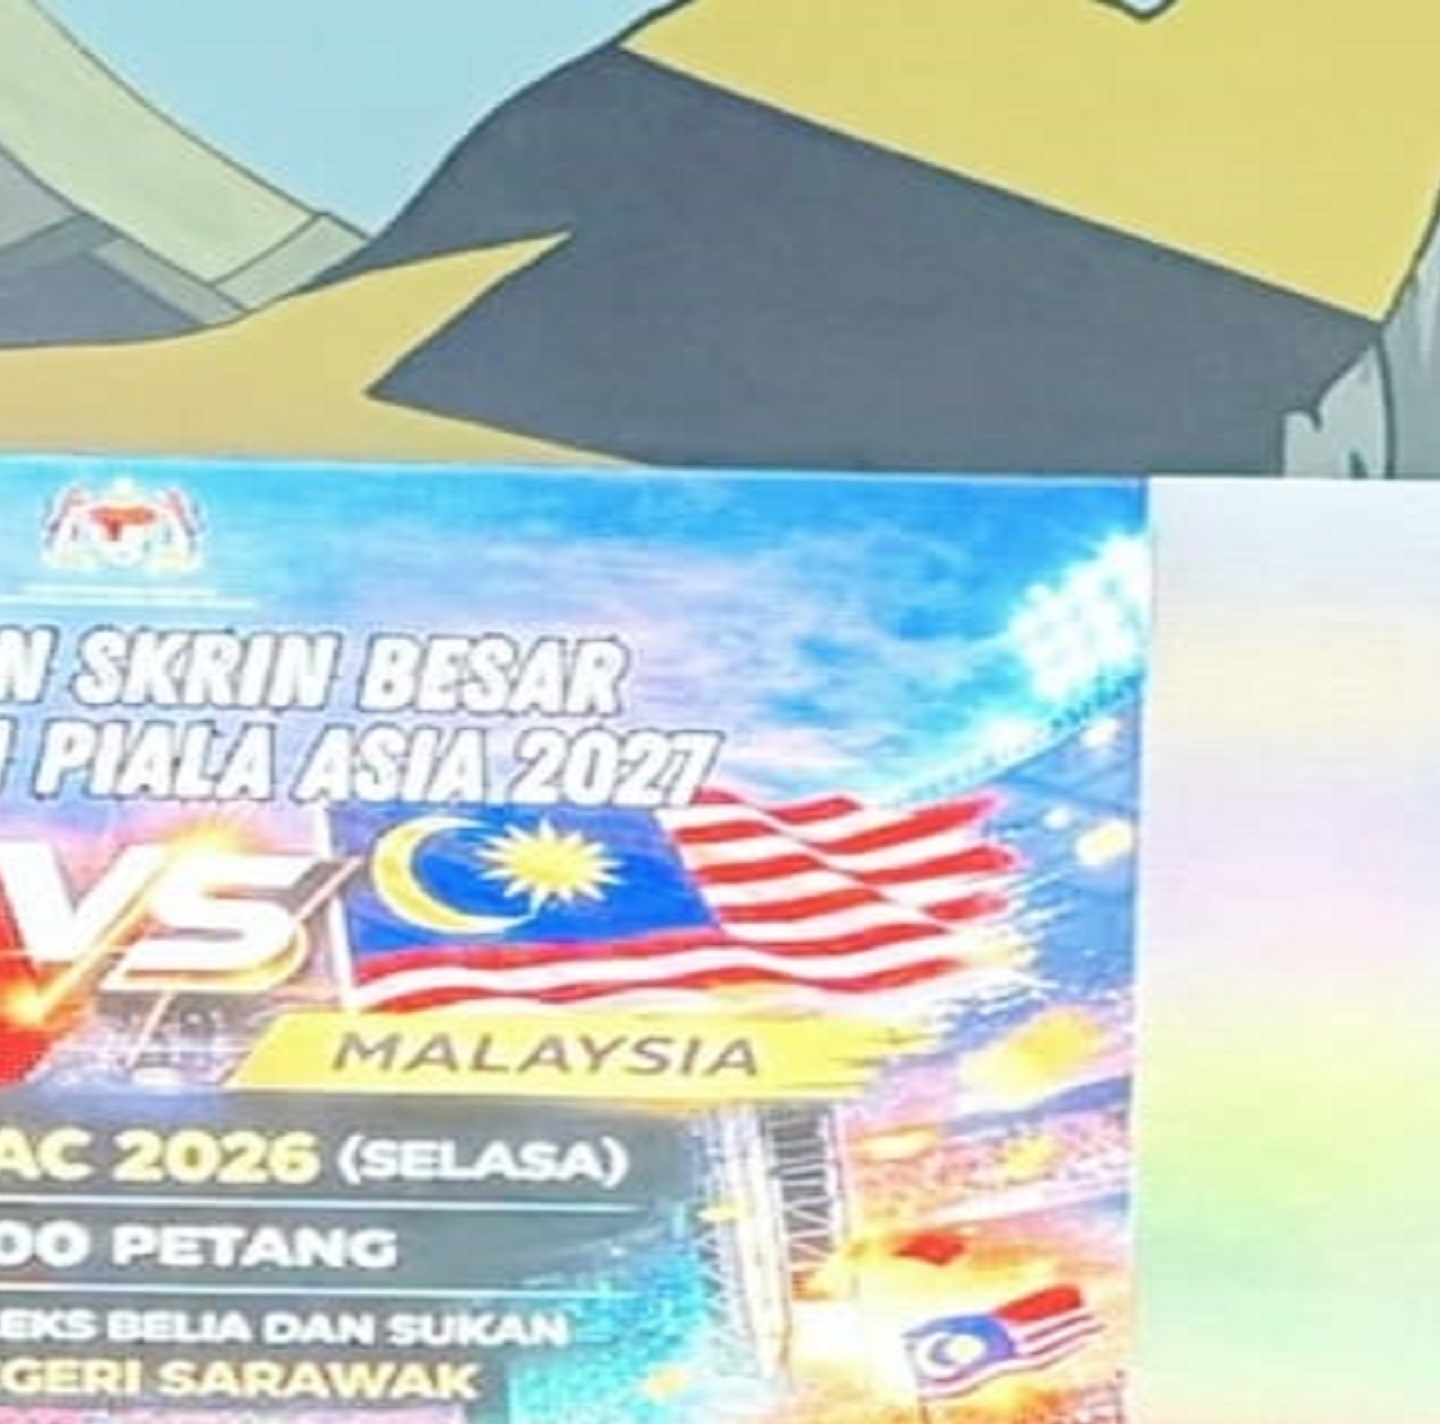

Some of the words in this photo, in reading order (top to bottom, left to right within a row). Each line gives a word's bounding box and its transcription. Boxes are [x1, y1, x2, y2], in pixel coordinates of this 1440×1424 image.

[76, 626, 337, 710] SKRIN
[363, 633, 630, 716] BESAR
[35, 720, 295, 801] PIALA
[302, 726, 496, 804] ASIA
[505, 728, 722, 806] 2027
[330, 1030, 760, 1078] MALAYSIA
[113, 1130, 320, 1184] 2026
[337, 1136, 629, 1189] (SELASA)
[112, 1223, 396, 1270] PETANG
[107, 1308, 251, 1343] BELIA
[264, 1311, 377, 1345] DAN
[390, 1312, 569, 1348] SUKAN
[158, 1360, 478, 1400] SARAWAK
